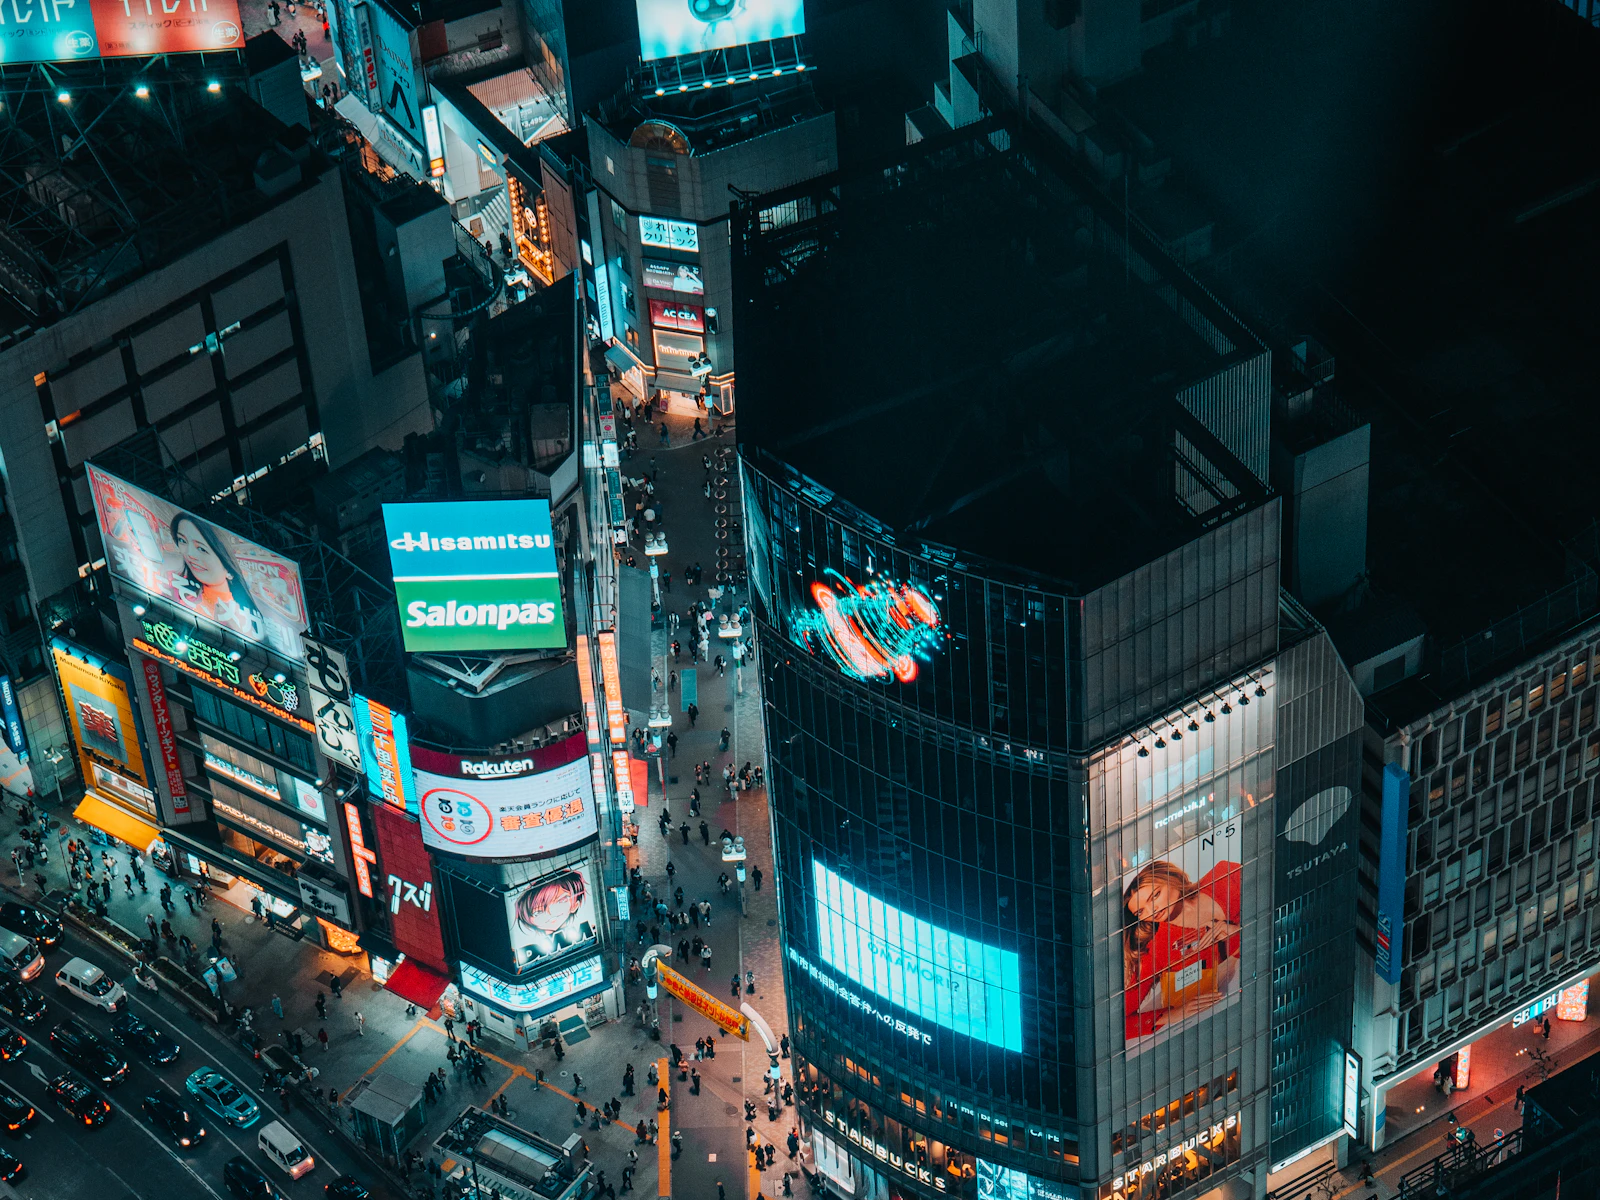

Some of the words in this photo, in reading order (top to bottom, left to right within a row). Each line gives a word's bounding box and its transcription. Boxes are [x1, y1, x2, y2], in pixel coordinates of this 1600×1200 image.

[644, 233, 696, 248] クリニック
[656, 222, 695, 236] れいわ
[663, 308, 697, 321] ACCEA
[390, 531, 550, 552] Hisamitsu
[406, 600, 555, 630] Salonpas
[60, 657, 98, 680] Matsumoto
[99, 675, 124, 692] KiYoshi
[188, 644, 240, 684] 西村
[78, 701, 118, 743] 薬
[147, 673, 176, 763] ウィンターフルーツギフト
[460, 759, 534, 776] Rakuten
[499, 787, 582, 813] 楽天会員ランクに応じて
[500, 797, 584, 831] 審査優遇
[1287, 842, 1348, 880] TSUTAYA
[469, 968, 593, 1005] 大盛堂書店
[1513, 990, 1564, 1029] SEIBU
[825, 1109, 947, 1190] STARBUCKS
[1112, 1115, 1237, 1191] STARBUCKS
